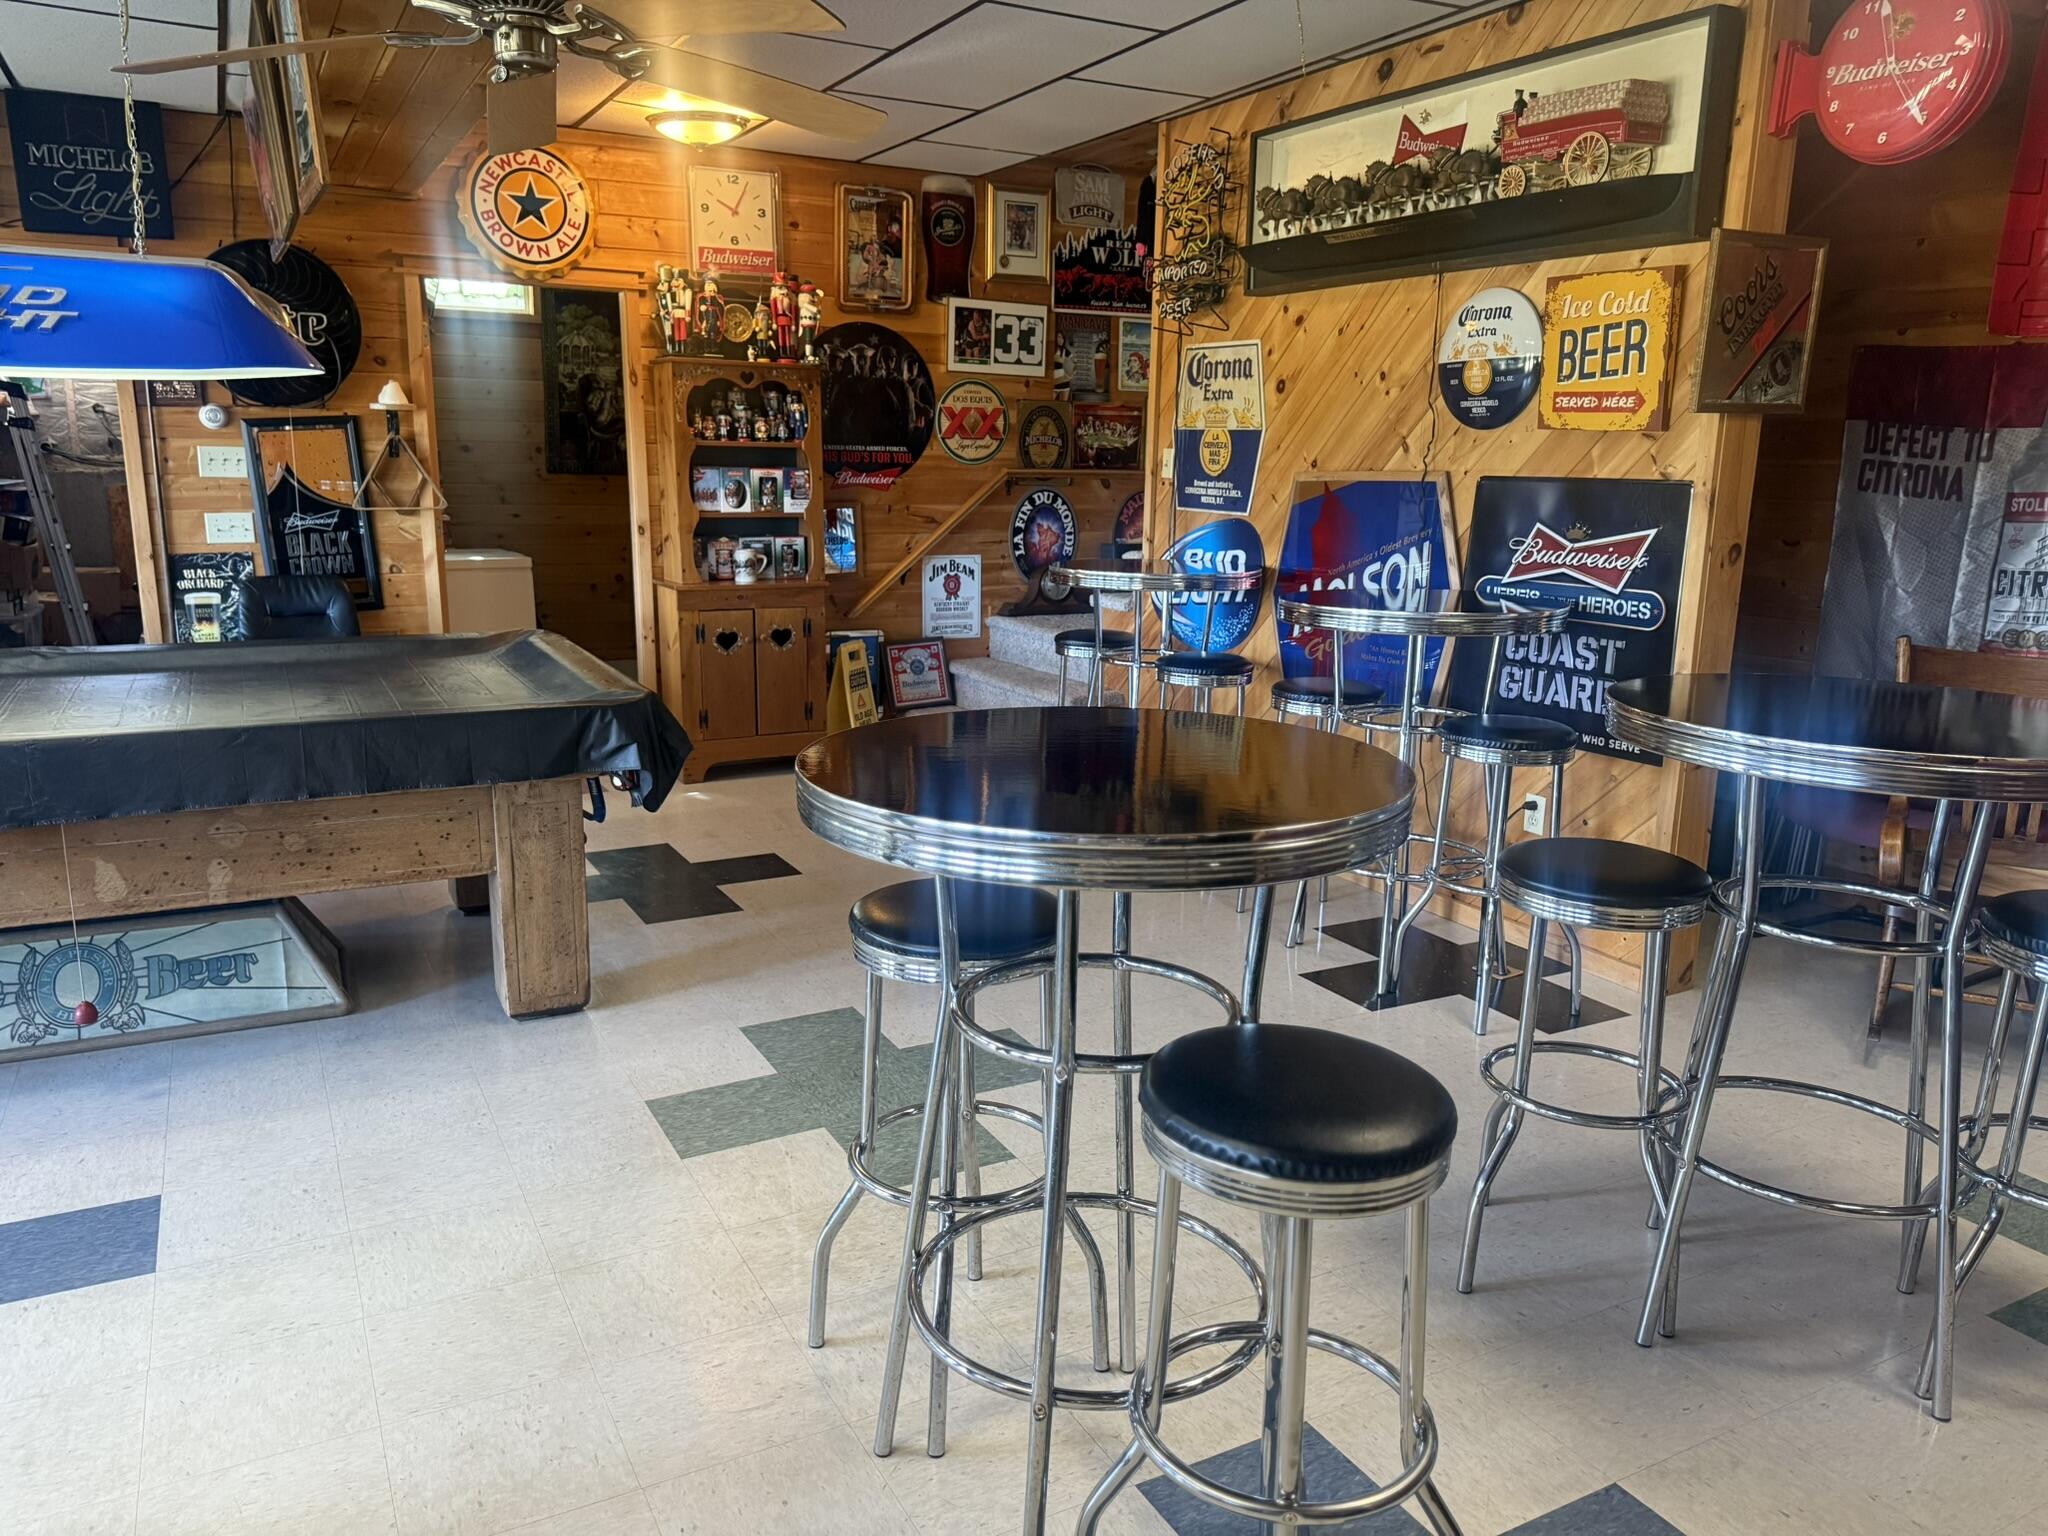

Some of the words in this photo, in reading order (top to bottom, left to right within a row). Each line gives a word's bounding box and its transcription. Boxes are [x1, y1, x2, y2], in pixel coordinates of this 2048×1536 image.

[1953, 8, 1966, 21] 2
[1843, 28, 1859, 40] 10
[1826, 66, 1836, 78] 9
[1832, 52, 1957, 86] Budweiser
[1946, 78, 1957, 90] 4
[1829, 100, 1839, 112] 8
[1845, 123, 1855, 135] 7
[1877, 132, 1887, 144] 6
[1398, 131, 1459, 152] Budwei
[25, 142, 154, 174] MICHELOB
[726, 175, 739, 184] 12
[1075, 173, 1110, 192] SAM
[30, 171, 160, 224] Light
[701, 203, 709, 213] 9
[757, 208, 766, 218] 3
[1073, 206, 1112, 221] LIGHT
[481, 209, 551, 258] BROWN
[556, 218, 581, 253] ALE
[731, 235, 739, 246] 6
[1106, 240, 1132, 249] RED
[701, 249, 774, 267] Budweiser
[1562, 294, 1592, 319] Ice
[1599, 289, 1652, 317] Cold
[1717, 254, 1777, 335] Coors
[1459, 304, 1513, 328] Corona
[995, 315, 1043, 364] 33
[1467, 326, 1497, 339] Extra
[1557, 319, 1650, 386] BEER
[1187, 352, 1254, 390] Corona
[952, 395, 968, 404] DOS
[970, 395, 992, 404] EQUIS
[1202, 383, 1233, 401] Extra
[1555, 396, 1599, 409] SERVED
[1602, 395, 1637, 409] HERE
[942, 406, 1004, 439] XX
[1212, 433, 1220, 441] LA
[1863, 421, 1950, 460] DEFECT
[1965, 427, 1998, 463] TO
[841, 451, 870, 464] BUD'S
[872, 452, 891, 464] FOR
[834, 470, 896, 485] Budweiser
[1857, 461, 1964, 502] CITRONA
[1032, 491, 1054, 506] DU
[1015, 500, 1033, 530] FIN
[1053, 497, 1075, 557] MONDE
[285, 531, 352, 558] BLACK
[1014, 534, 1026, 557] LA
[1380, 539, 1402, 556] Oldest
[1509, 537, 1648, 571] Budweiser
[183, 568, 216, 579] BLACK
[289, 554, 355, 576] CROWN
[929, 562, 947, 582] JIM
[949, 559, 975, 581] BEAM
[176, 579, 225, 590] ORCHARD
[1579, 594, 1651, 620] HEROES
[1504, 632, 1626, 676] COAST
[902, 678, 937, 688] Budweiser
[1582, 733, 1605, 746] WHO
[1608, 739, 1640, 754] SERVE
[68, 950, 113, 987] PILSNER
[143, 952, 259, 1000] Beer
